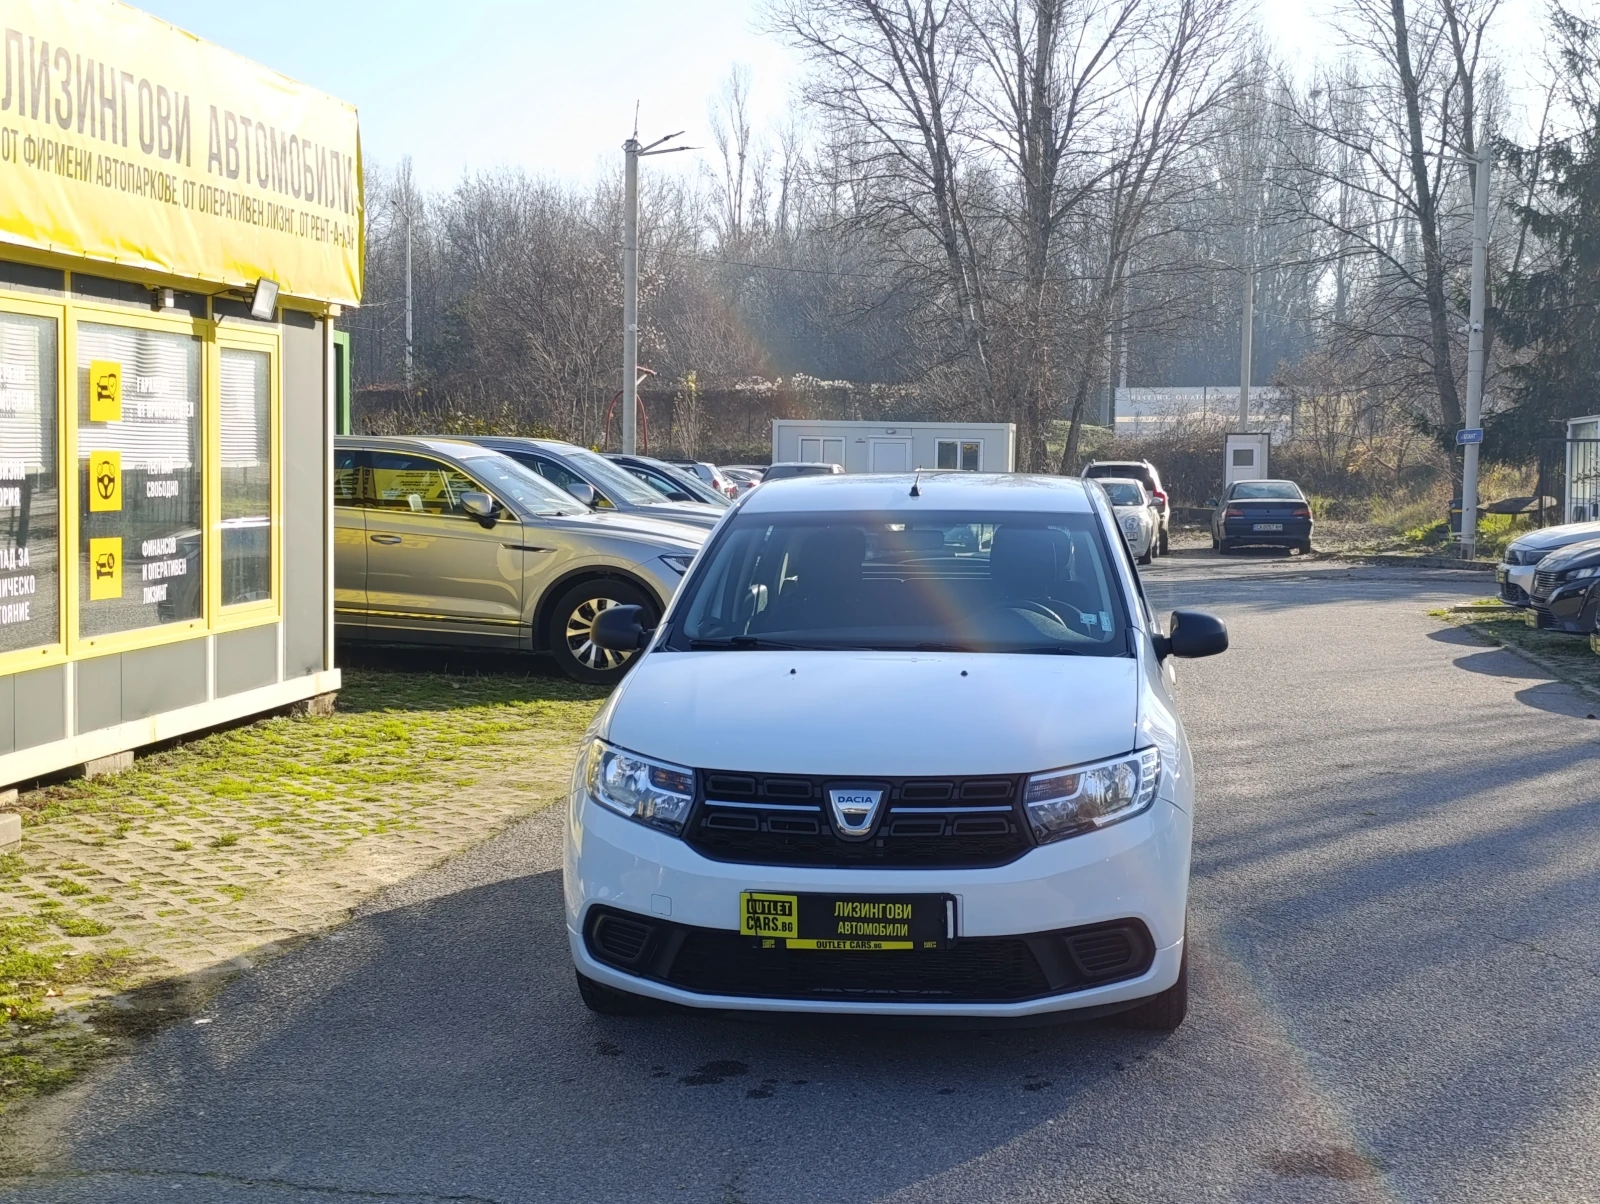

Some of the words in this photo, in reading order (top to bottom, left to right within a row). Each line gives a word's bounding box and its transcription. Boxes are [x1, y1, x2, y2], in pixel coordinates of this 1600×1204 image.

[1, 27, 191, 168] ЛИЗИНГОВИ
[207, 104, 356, 216] АВТОМОБИЛИ
[1, 126, 19, 162] ОТ
[23, 134, 93, 183] ФИРМЕНИ
[182, 180, 197, 210] ОТ
[198, 184, 264, 228] ОПЕРАТИВЕН
[299, 209, 310, 237] ОТ
[146, 480, 179, 498] СВОБОДНО
[142, 537, 177, 557] ФИНАНСОВ
[18, 547, 30, 568] ЗА
[142, 564, 147, 581] И
[148, 558, 187, 580] ОПЕРАТИВЕН
[0, 575, 35, 598] ИЧЕСКО
[143, 584, 168, 604] ЛИЗИНГ
[837, 796, 873, 804] DACIA
[748, 900, 791, 915] OUTLET
[834, 901, 912, 920] ЛИЗИНГОВИ
[837, 921, 909, 937] АВТОМОБИЛИ
[816, 940, 847, 949] OUTLET
